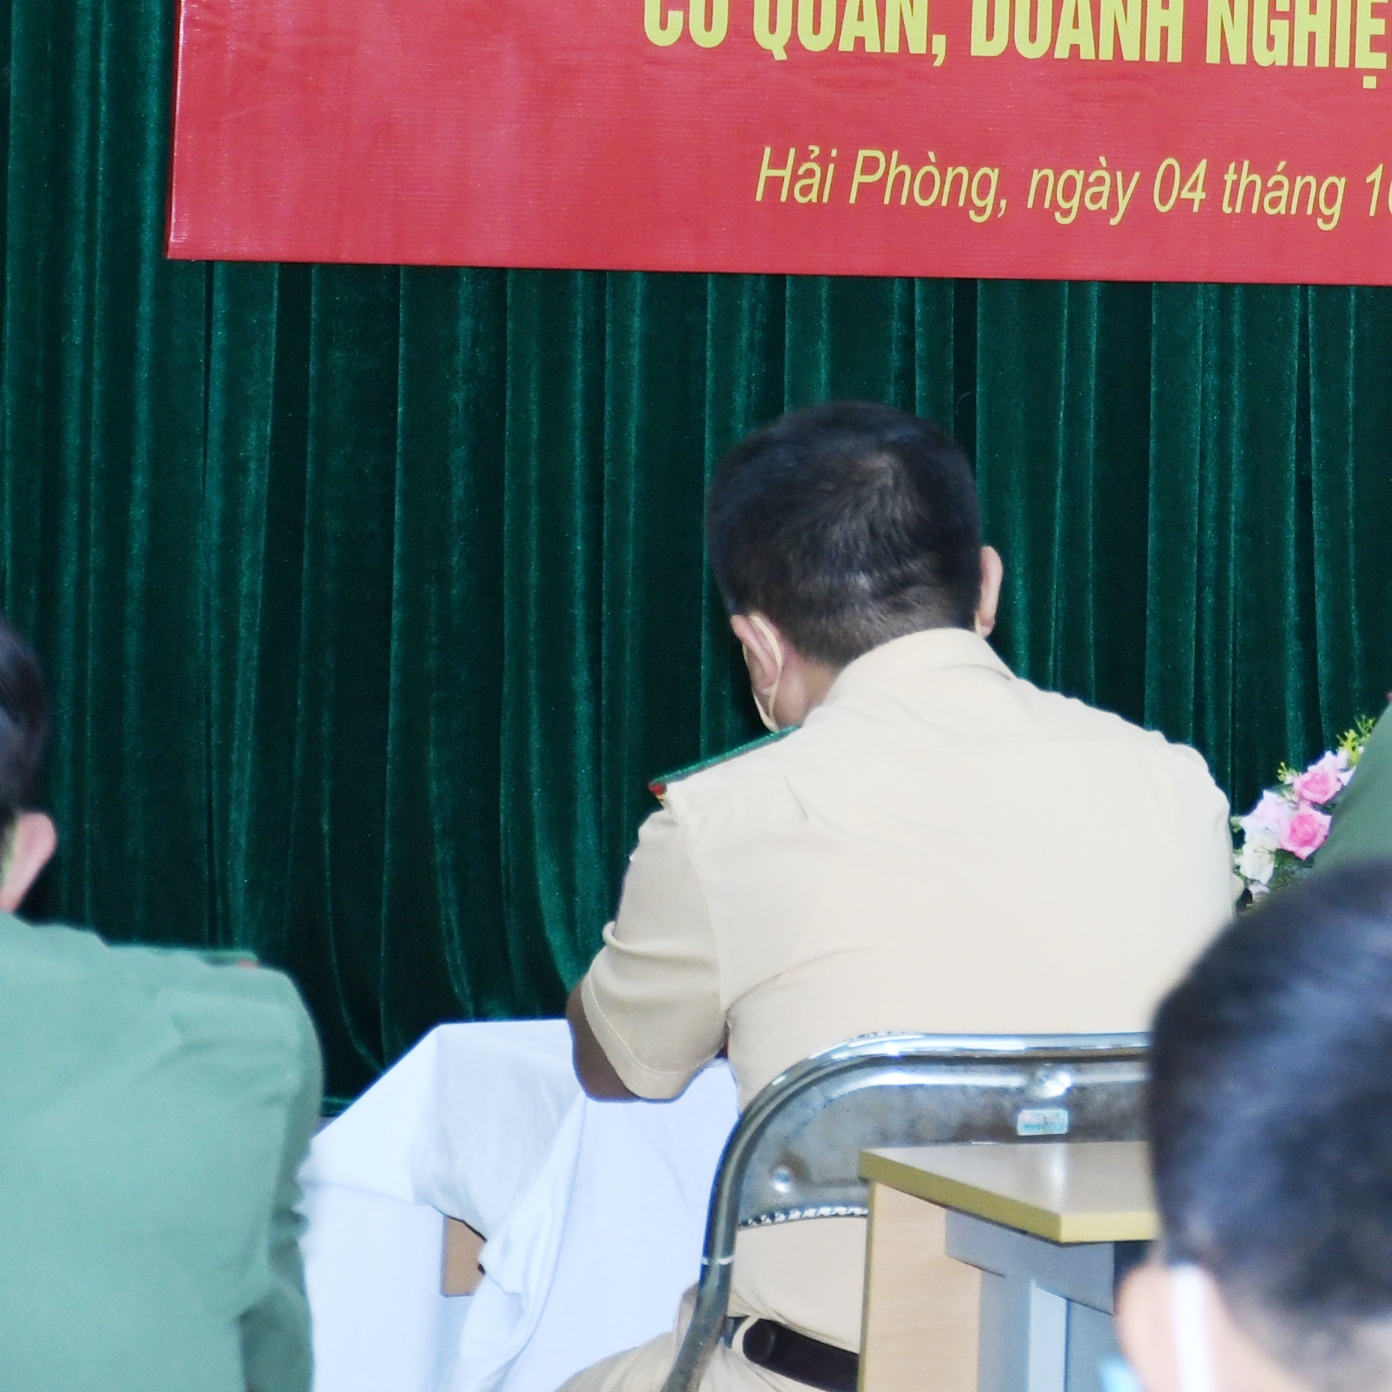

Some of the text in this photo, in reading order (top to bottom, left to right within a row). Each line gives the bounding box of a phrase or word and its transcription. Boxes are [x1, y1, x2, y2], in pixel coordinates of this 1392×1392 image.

[755, 144, 835, 204] Hải
[848, 149, 1007, 224] Phòng,
[1027, 157, 1141, 226] ngày
[1153, 157, 1208, 213] 04
[1221, 159, 1347, 231] tháng
